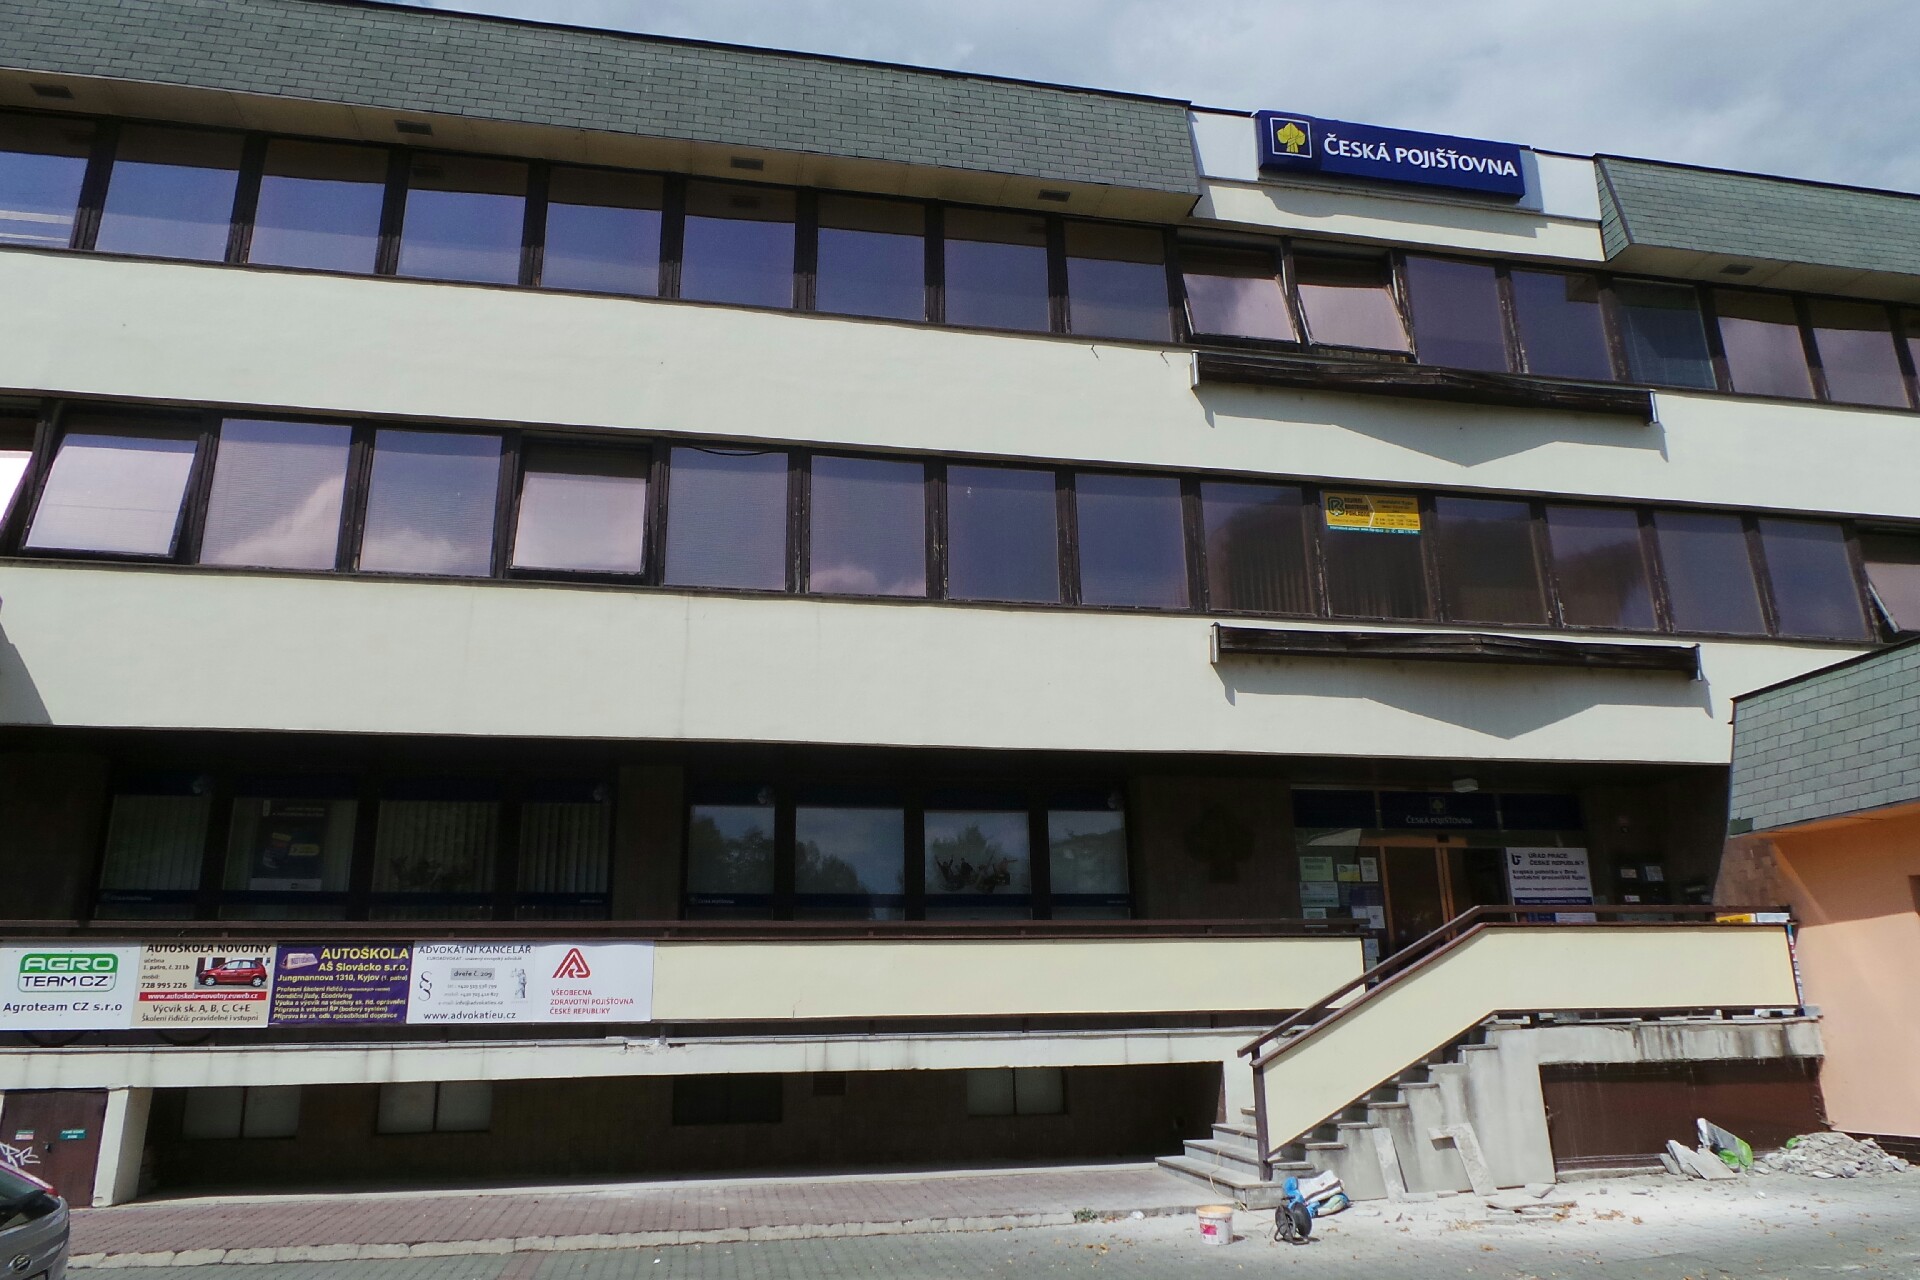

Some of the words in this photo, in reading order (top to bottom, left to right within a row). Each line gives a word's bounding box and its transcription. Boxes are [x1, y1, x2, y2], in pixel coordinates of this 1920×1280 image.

[1323, 133, 1391, 163] ČESKÁ
[1395, 146, 1518, 177] POJIŠŤOVNA
[147, 943, 214, 954] AUTOŠKOLA
[217, 943, 271, 953] NOVOTNÝ
[320, 946, 409, 960] AUTOŠKOLA
[418, 944, 477, 954] ADVOKÁTNÍ
[479, 944, 532, 954] KANCELÁŘ
[24, 957, 114, 971] AGRO
[318, 961, 334, 971] AŠ
[336, 961, 382, 972] Slovácko
[384, 963, 409, 971] s.r.o.
[22, 975, 76, 987] TEAM
[277, 974, 334, 983] Jungmannova
[335, 974, 356, 982] 1310,
[357, 974, 380, 983] Kyjov
[550, 996, 590, 1006] ZDRAVOTNÍ
[591, 996, 634, 1005] POJIŠŤOVNA
[3, 1002, 68, 1014] Agroteam
[72, 1002, 89, 1011] CZ
[93, 1002, 123, 1011] s.r.o
[152, 1003, 182, 1014] Výcvik
[184, 1003, 196, 1012] sk.
[198, 1004, 208, 1013] A,
[210, 1004, 219, 1013] B,
[221, 1004, 230, 1013] C,
[232, 1004, 251, 1012] C+E
[549, 1006, 571, 1015] ČESKÉ
[573, 1007, 611, 1015] REPUBLIKY
[142, 1012, 166, 1022] Školení
[423, 1010, 516, 1020] www.advokatieu.cz
